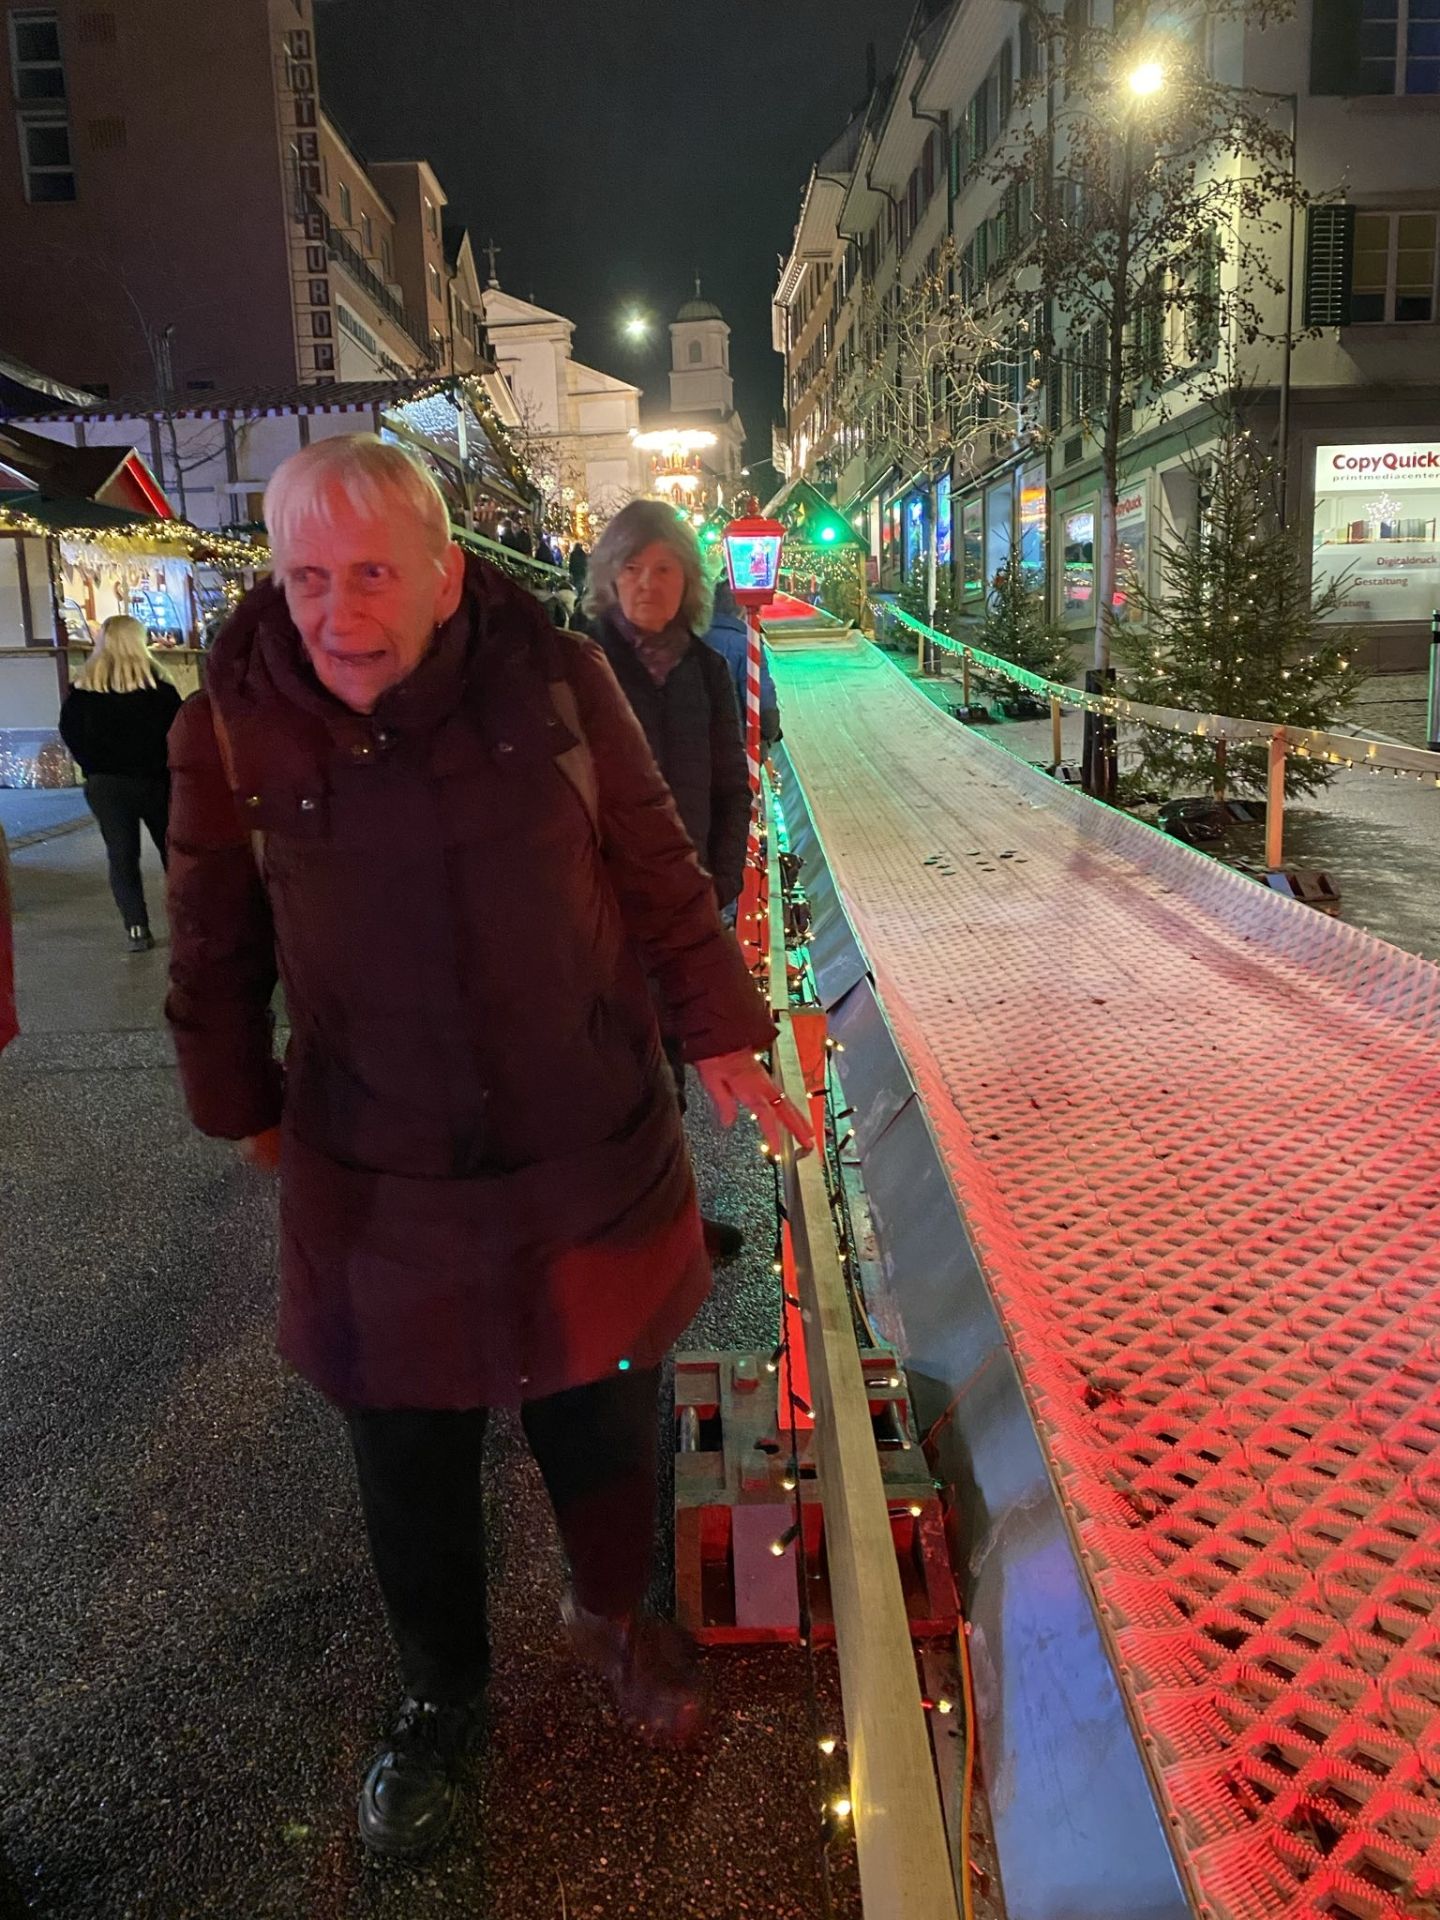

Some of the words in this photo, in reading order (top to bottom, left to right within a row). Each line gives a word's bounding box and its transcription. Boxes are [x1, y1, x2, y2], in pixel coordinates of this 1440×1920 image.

[291, 29, 321, 194] HOTEL
[306, 212, 334, 384] EUROP
[1332, 451, 1440, 472] CopyQuick
[1333, 473, 1440, 482] printmediacenter
[1376, 555, 1437, 567] Digitaldruck
[1354, 577, 1408, 587] Gestaltung
